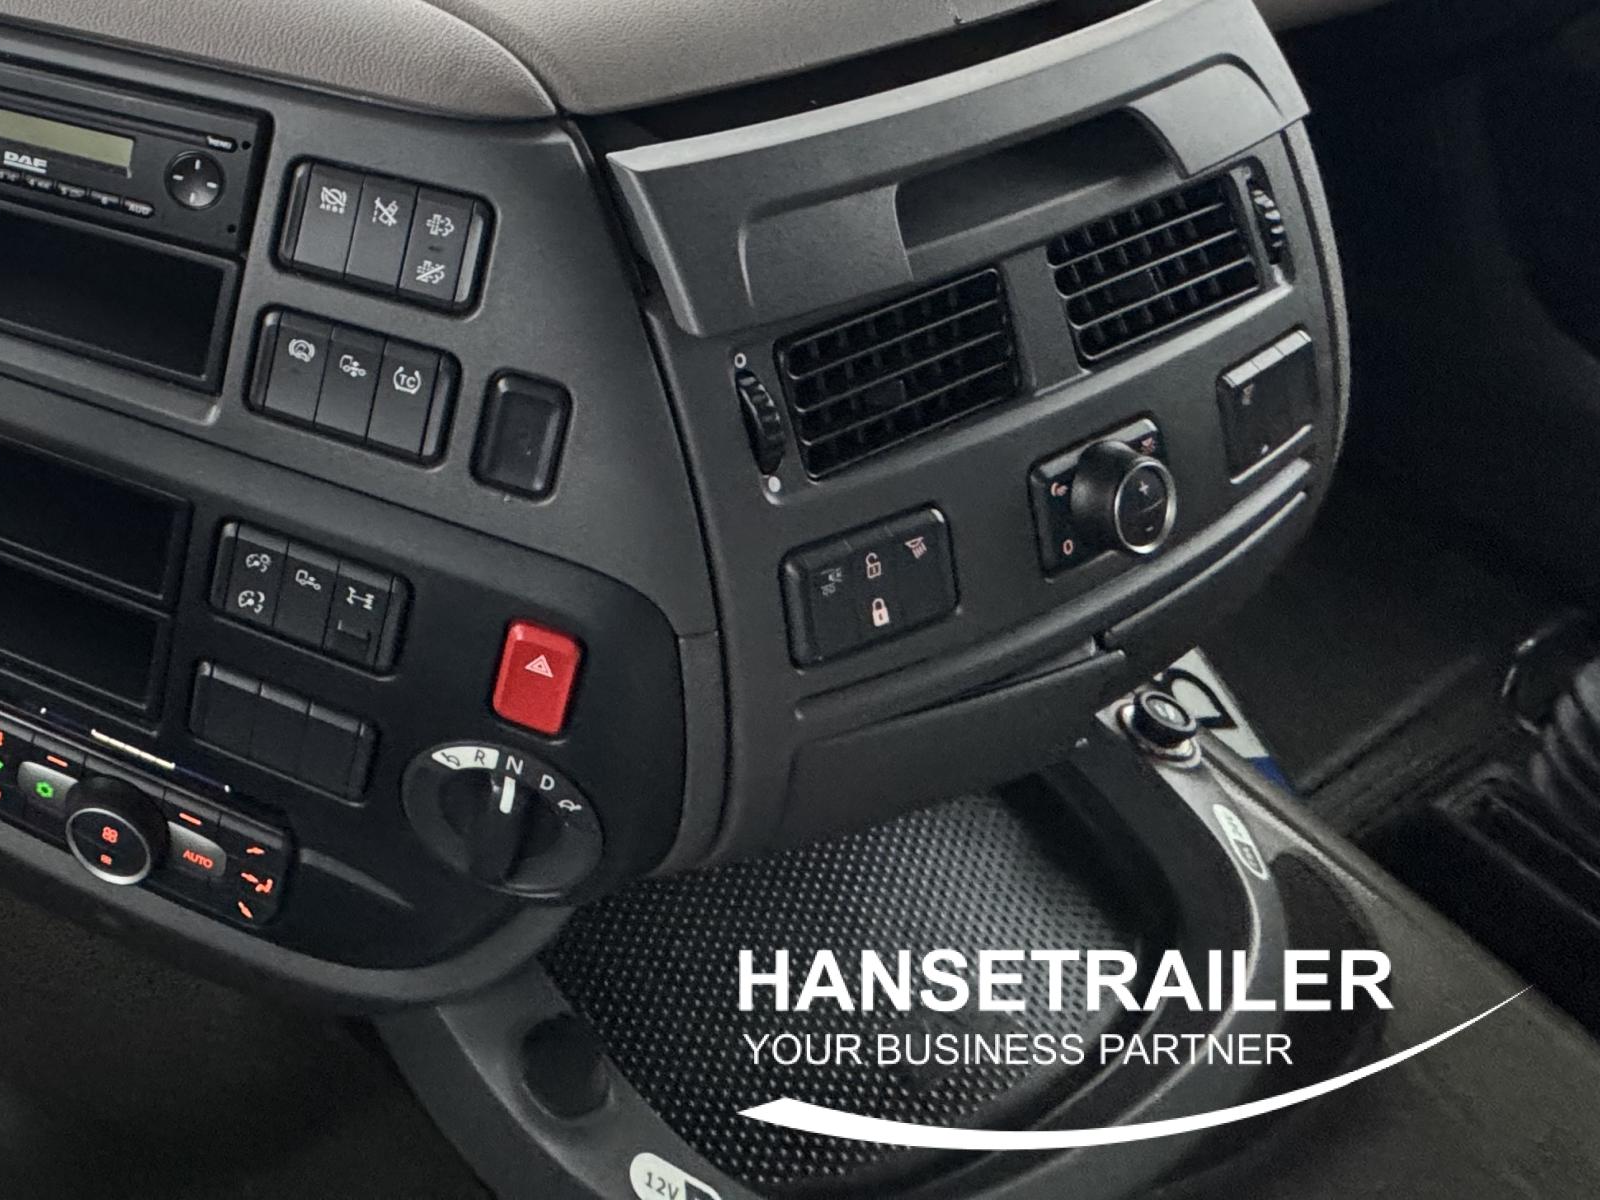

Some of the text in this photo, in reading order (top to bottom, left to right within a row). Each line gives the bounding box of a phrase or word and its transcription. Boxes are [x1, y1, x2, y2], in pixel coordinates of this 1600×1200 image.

[3, 151, 48, 171] DAF
[399, 374, 416, 388] TC
[473, 749, 555, 791] R N D
[182, 848, 214, 869] AUTO
[645, 1171, 680, 1200] 12V
